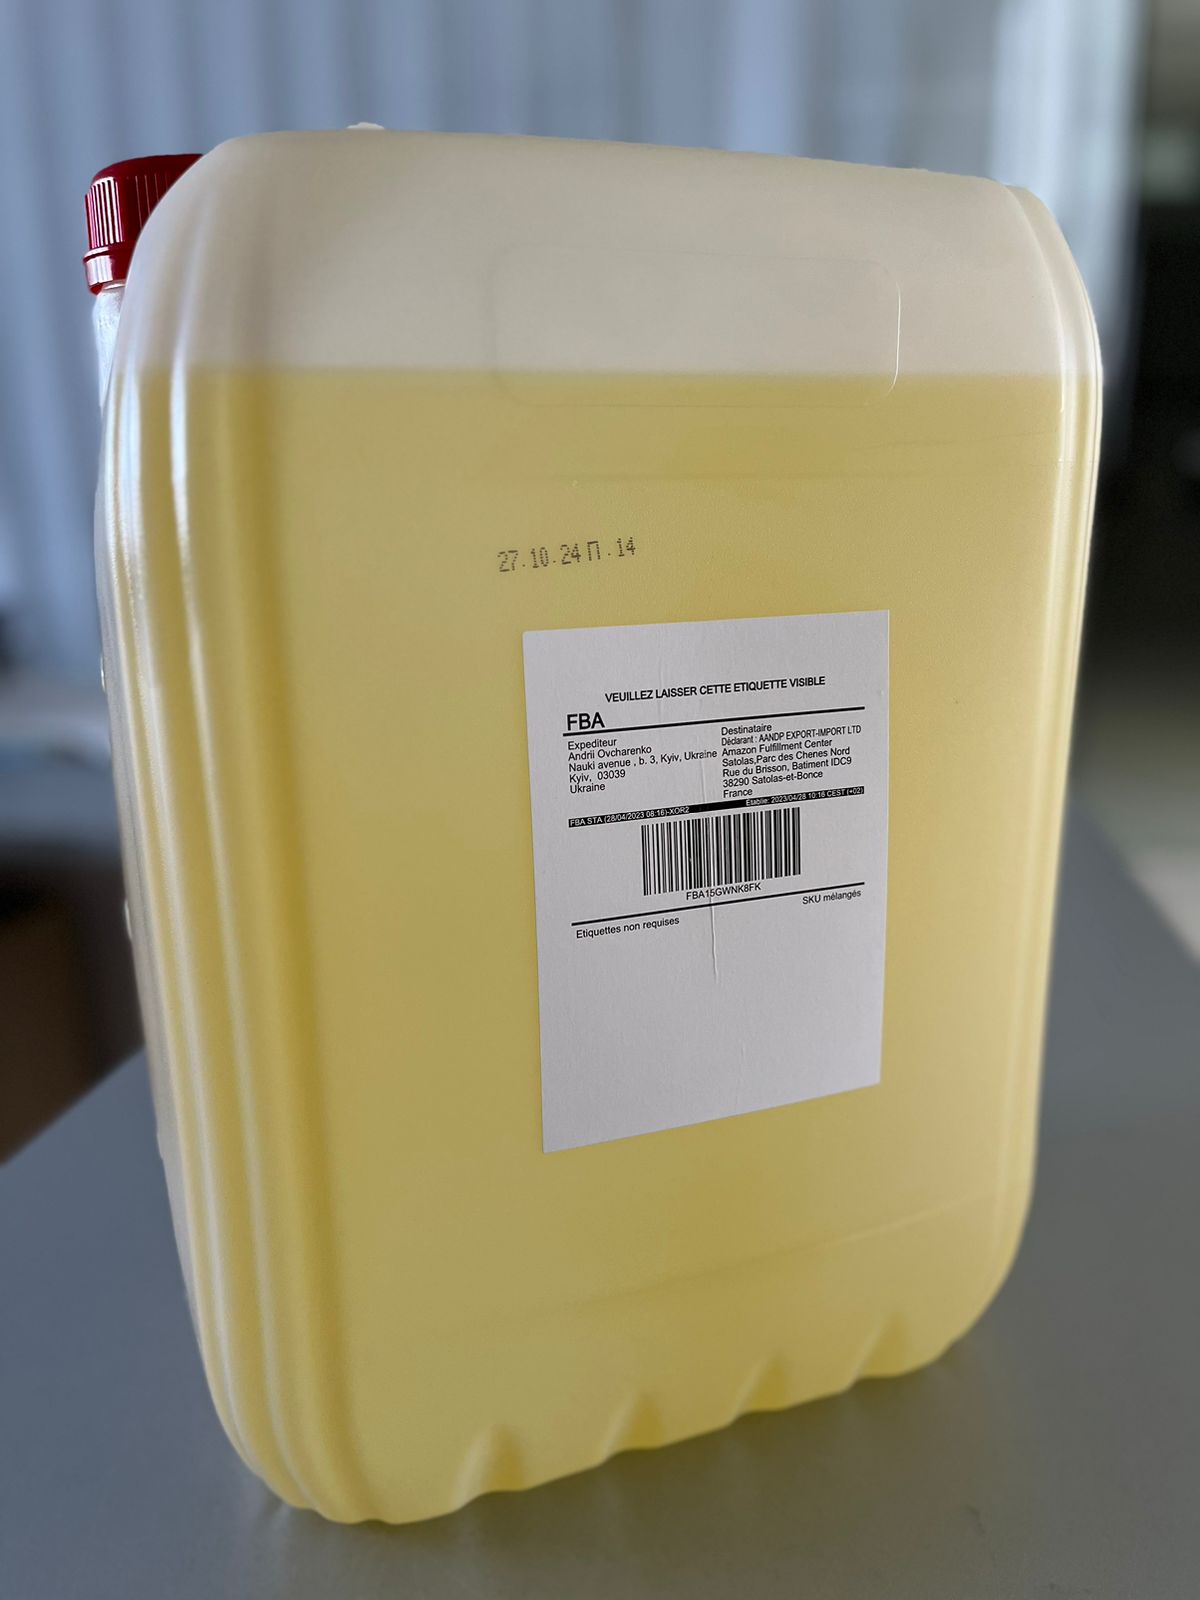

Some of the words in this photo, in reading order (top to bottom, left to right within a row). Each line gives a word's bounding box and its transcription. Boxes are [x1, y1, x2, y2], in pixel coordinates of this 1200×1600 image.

[498, 544, 581, 572] 27.10.24
[605, 690, 653, 702] VEUILLEZ
[656, 686, 697, 699] LAISSER
[700, 683, 732, 695] CETTE
[734, 679, 787, 692] ETIQUETTE
[789, 676, 825, 687] VISIBLE
[567, 712, 605, 730] FBA
[722, 723, 772, 736] Destinataire
[722, 735, 753, 746] Déclarant
[759, 732, 784, 742] AANDP
[786, 726, 846, 739] EXPORT-IMPORT
[848, 725, 861, 734] LTD
[568, 738, 617, 751] Expediteur
[722, 744, 756, 756] Amazon
[760, 742, 802, 753] Fulfillment
[805, 739, 832, 749] Center
[568, 750, 595, 761] Andrii
[598, 746, 652, 758] Ovcharenko
[569, 761, 595, 772] Nauki
[598, 758, 631, 769] avenue
[639, 757, 647, 765] b.
[650, 756, 658, 764] 3,
[660, 753, 682, 765] Kyiv,
[684, 750, 718, 760] Ukraine
[722, 755, 776, 767] Satolas,Parc
[778, 752, 793, 762] des
[796, 749, 828, 759] Chenes
[830, 747, 850, 756] Nord
[723, 768, 740, 777] Rue
[743, 766, 753, 775] du
[756, 763, 789, 774] Brisson,
[792, 759, 828, 770] Batiment
[831, 756, 852, 766] IDC9
[570, 774, 592, 784] Kyiv,
[598, 769, 626, 780] 03039
[723, 778, 749, 787] 38290
[752, 771, 823, 784] Satolas-et-Bonce
[570, 783, 605, 794] Ukraine
[723, 788, 752, 798] France
[771, 794, 806, 804] 2023/04/28
[827, 788, 845, 797] CEST
[846, 787, 863, 795] (+02)
[570, 818, 585, 826] FBA
[587, 816, 602, 824] STA
[604, 810, 644, 823] (28/04/2023
[686, 882, 761, 901] FBA15GWNK8FK
[802, 894, 821, 904] SKU
[824, 890, 862, 903] mélangés
[576, 924, 621, 938] Etiquettes
[624, 922, 640, 932] non
[643, 916, 680, 930] requises
